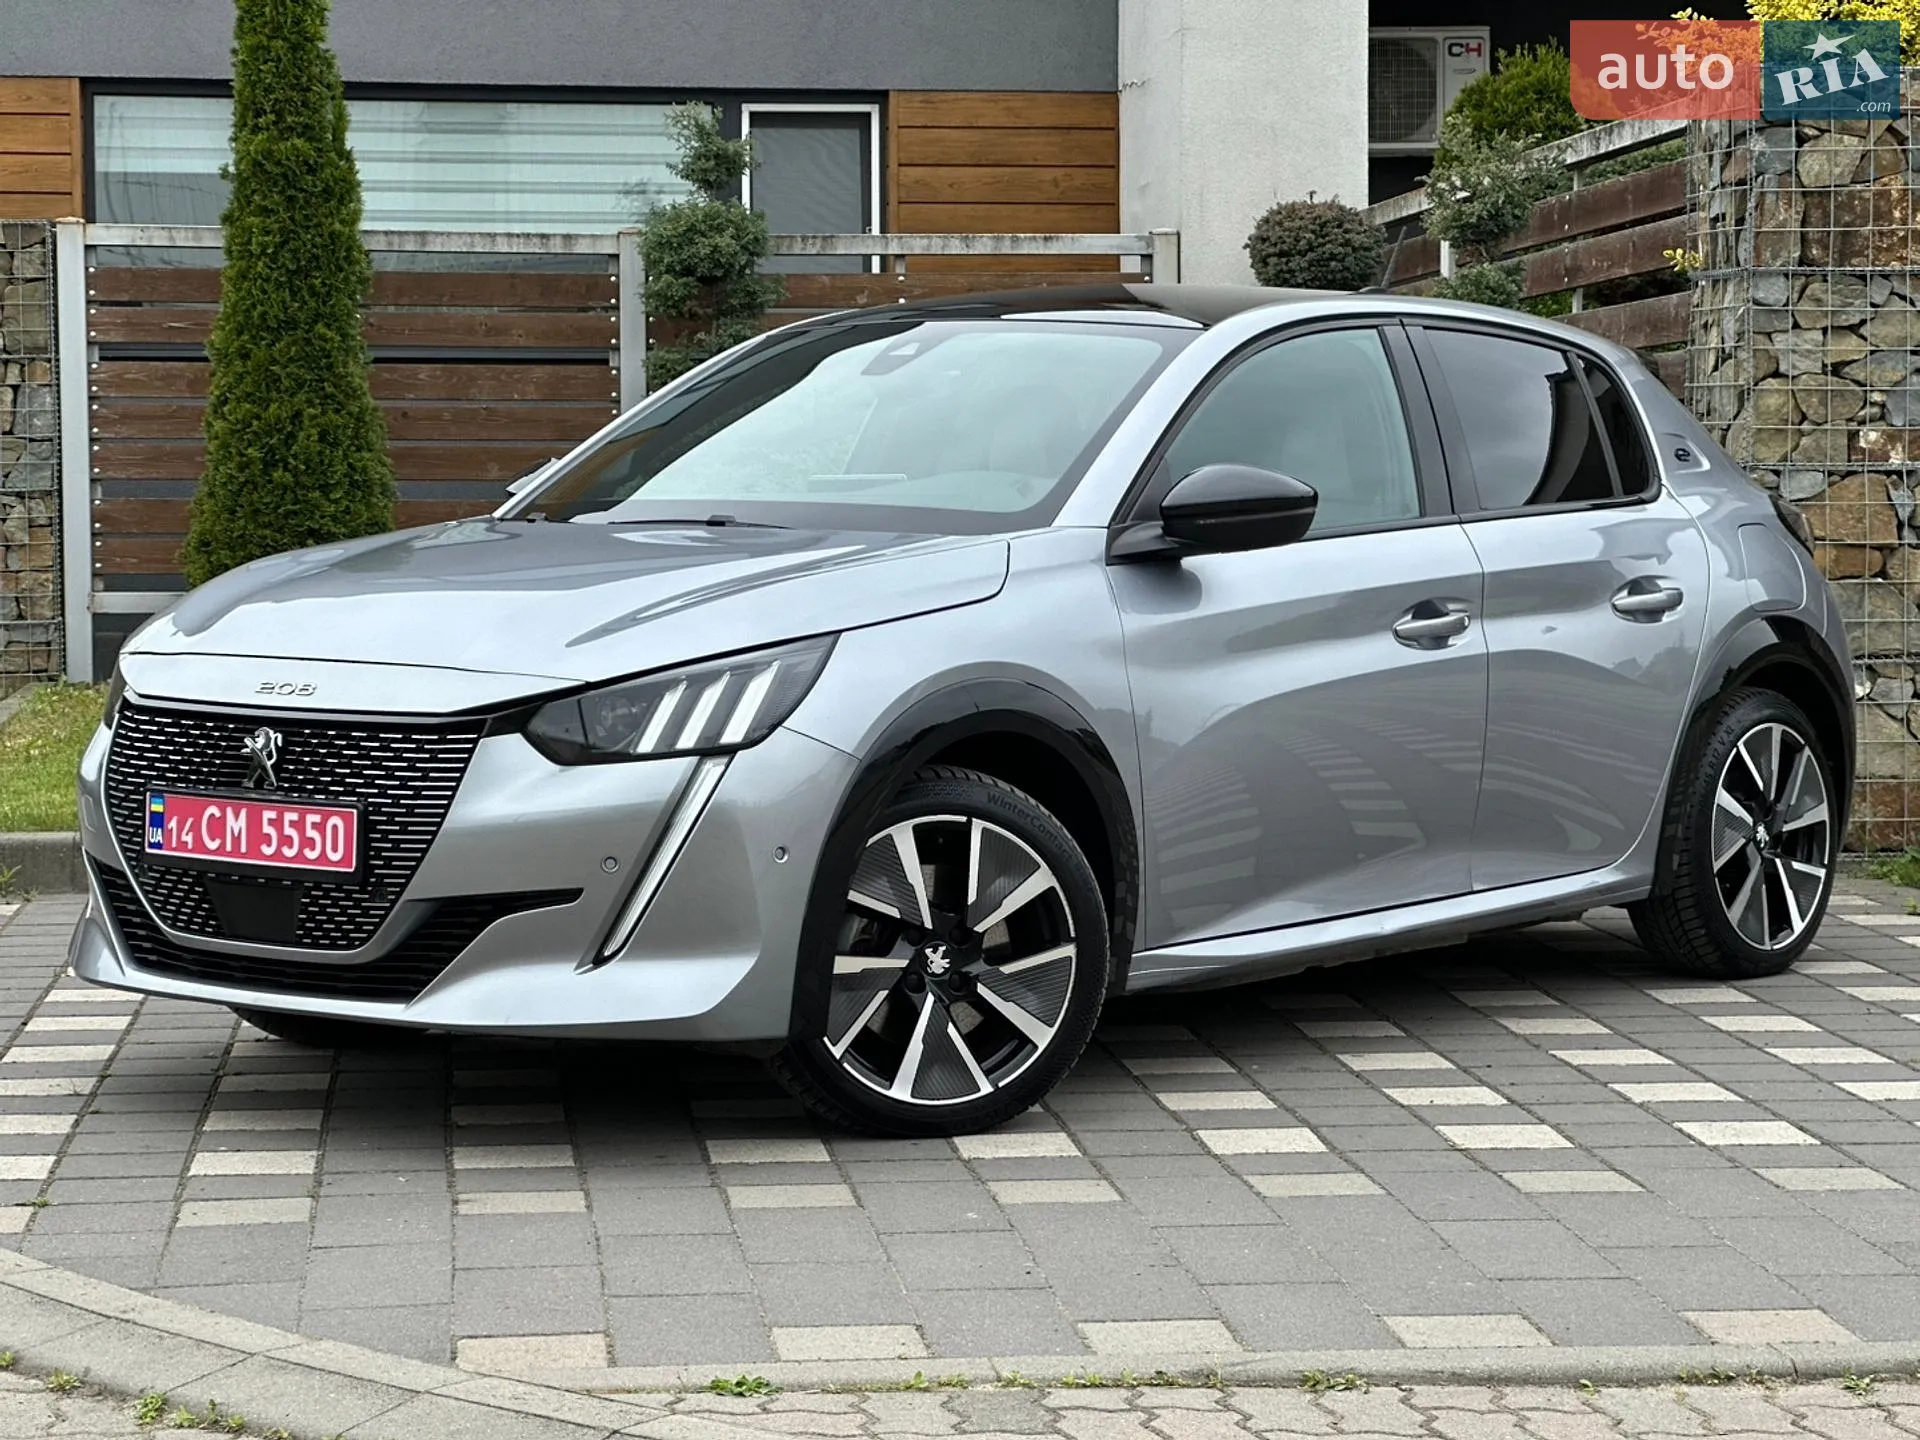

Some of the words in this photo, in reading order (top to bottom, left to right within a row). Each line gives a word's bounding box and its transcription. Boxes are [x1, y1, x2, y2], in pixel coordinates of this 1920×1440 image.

[1447, 42, 1483, 57] CH
[255, 681, 317, 696] 208
[148, 826, 163, 844] UA
[260, 809, 345, 862] 5550
